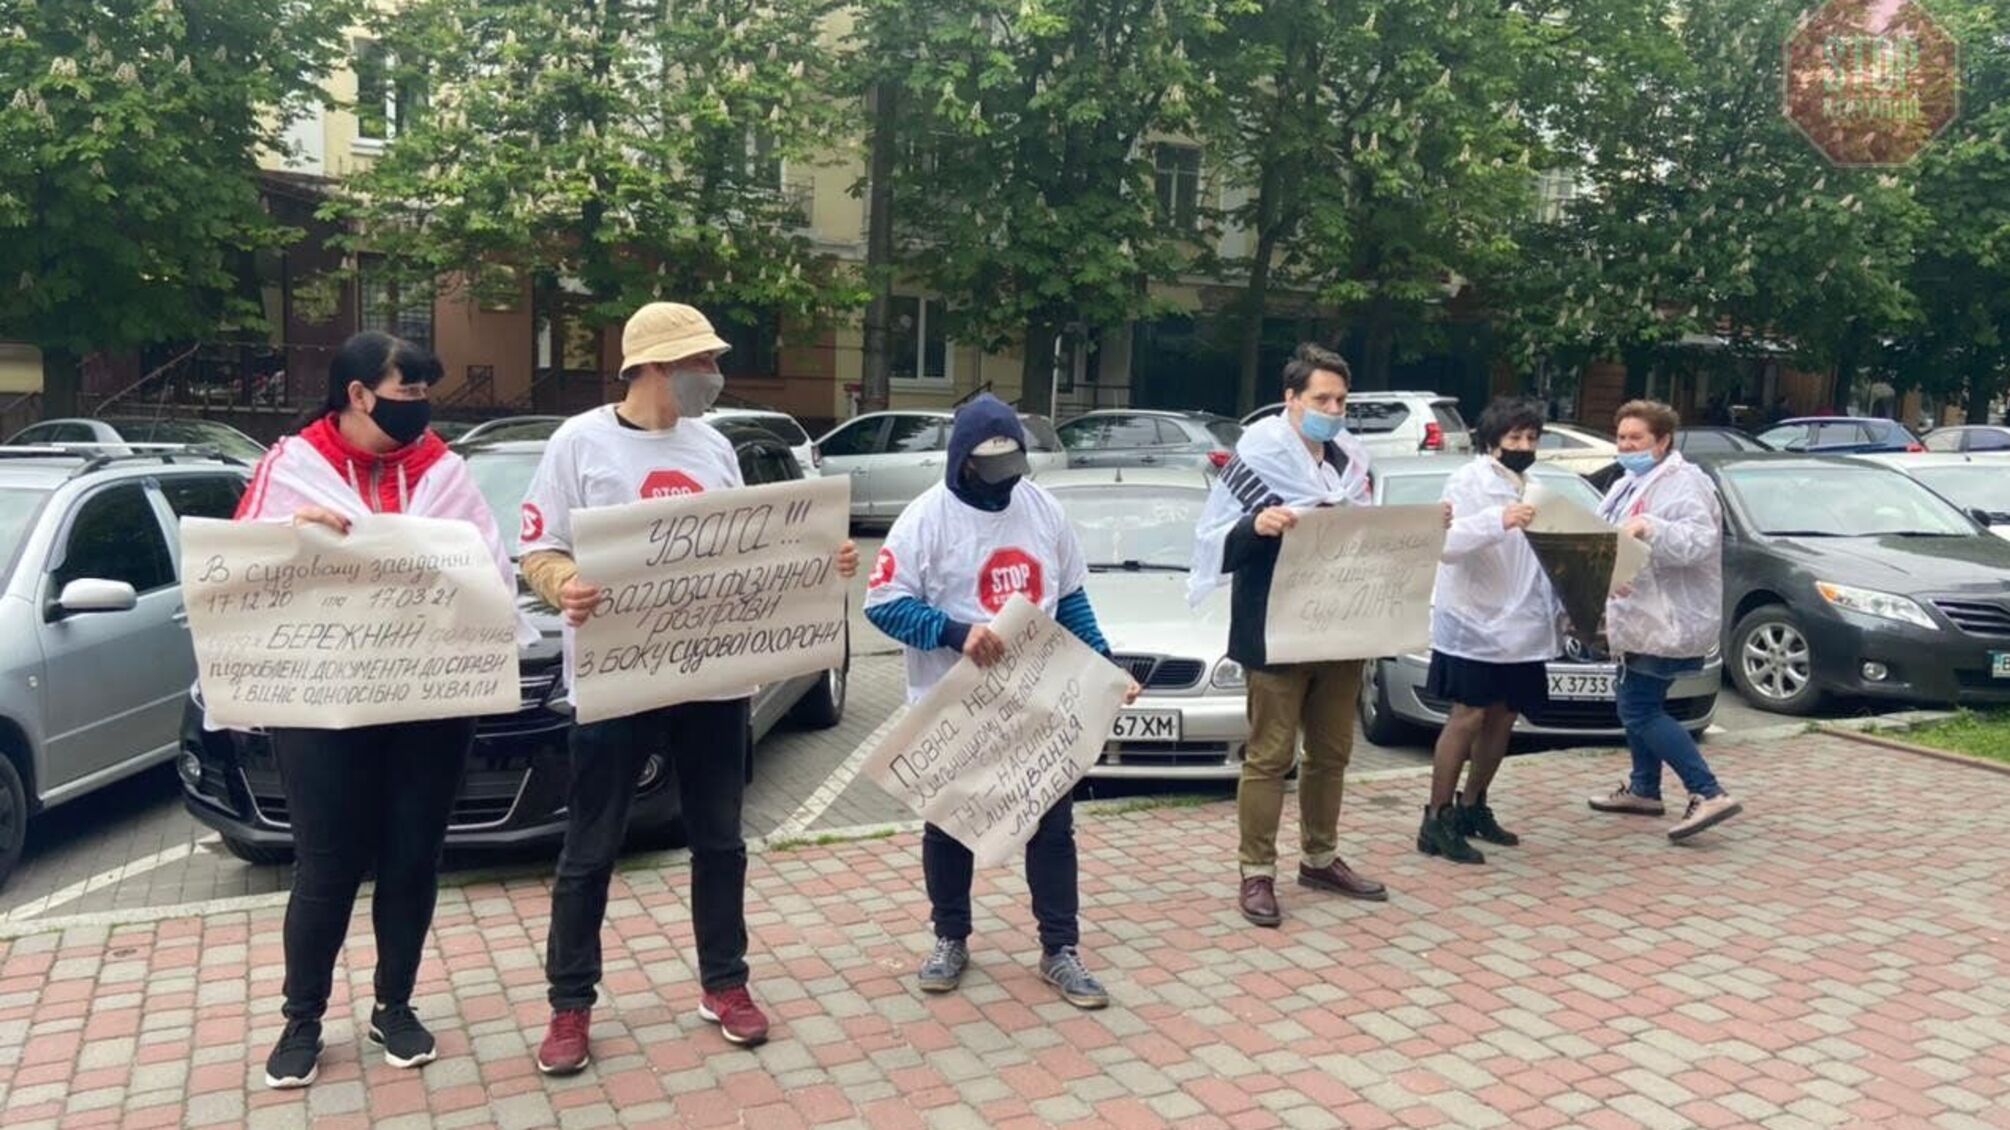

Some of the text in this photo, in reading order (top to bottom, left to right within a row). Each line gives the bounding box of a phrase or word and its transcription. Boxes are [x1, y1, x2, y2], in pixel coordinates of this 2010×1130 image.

[646, 504, 773, 567] УВАГА
[198, 554, 231, 583] В
[245, 554, 361, 593] судовому
[991, 563, 1030, 593] STOP
[267, 613, 427, 650] БЕРЕЖНИЙ
[310, 657, 420, 682] ДОКУМЕНТИ
[599, 641, 671, 676] БОКУ
[303, 682, 411, 706] ОДНООСІБНО
[421, 679, 499, 700] УХВАЛИ
[1566, 676, 1608, 693] 3733
